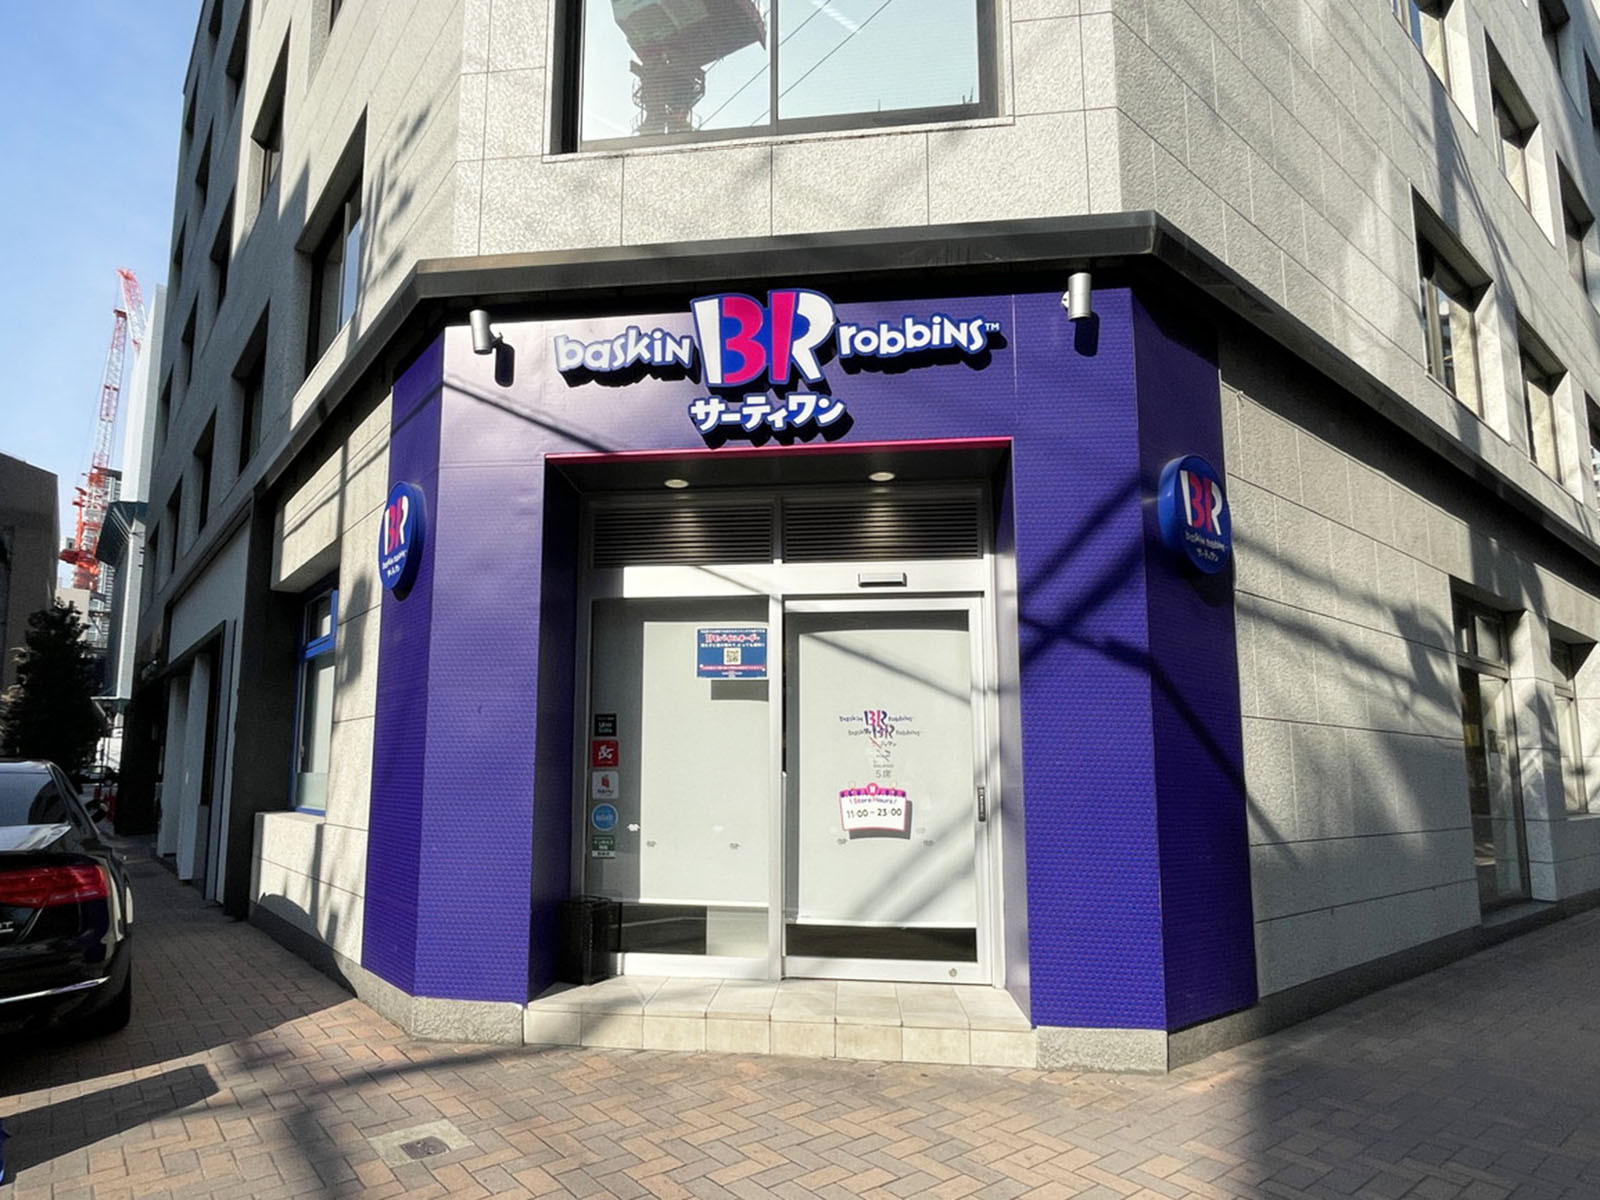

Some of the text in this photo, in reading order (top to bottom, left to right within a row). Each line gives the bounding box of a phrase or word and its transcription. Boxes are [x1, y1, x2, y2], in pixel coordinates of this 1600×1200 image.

[553, 325, 695, 372] baskin
[690, 288, 838, 387] BR
[688, 391, 846, 432] サーティワン
[1180, 470, 1222, 536] BR
